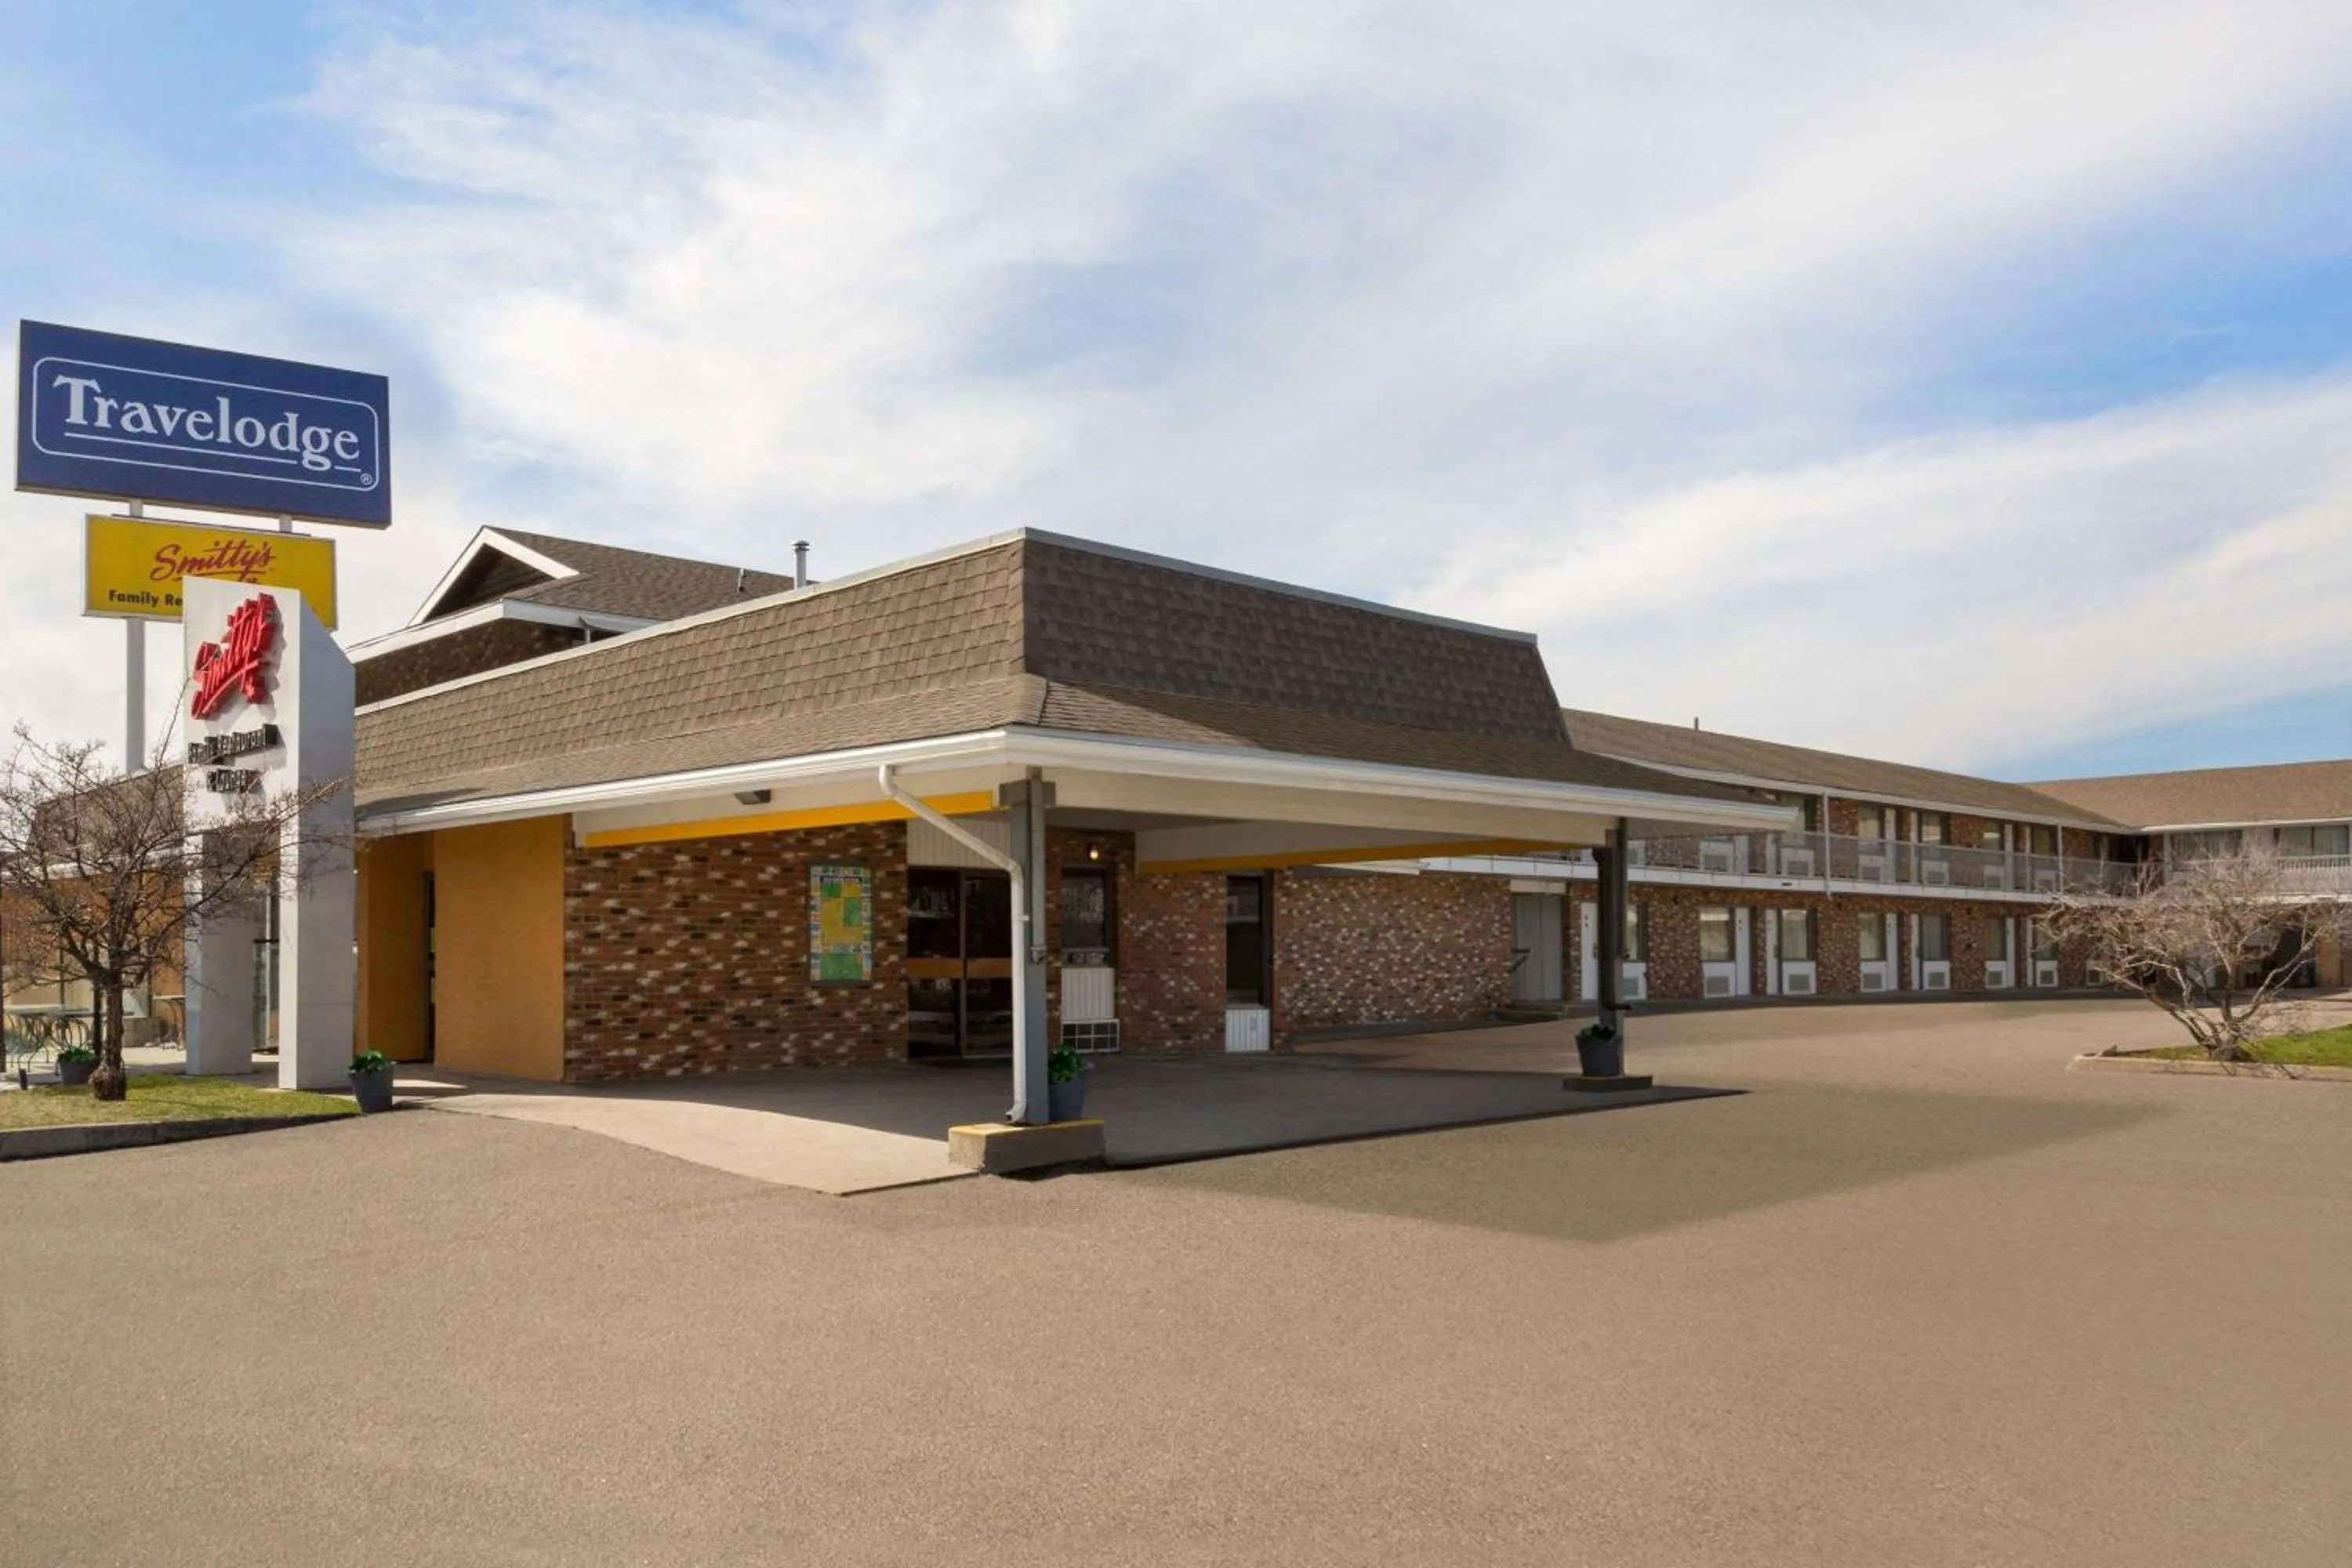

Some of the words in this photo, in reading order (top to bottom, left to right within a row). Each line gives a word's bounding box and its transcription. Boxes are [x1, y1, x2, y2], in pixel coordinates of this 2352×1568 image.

[53, 376, 361, 470] Travelodge
[151, 539, 277, 582] Smitty's
[109, 589, 159, 608] Family
